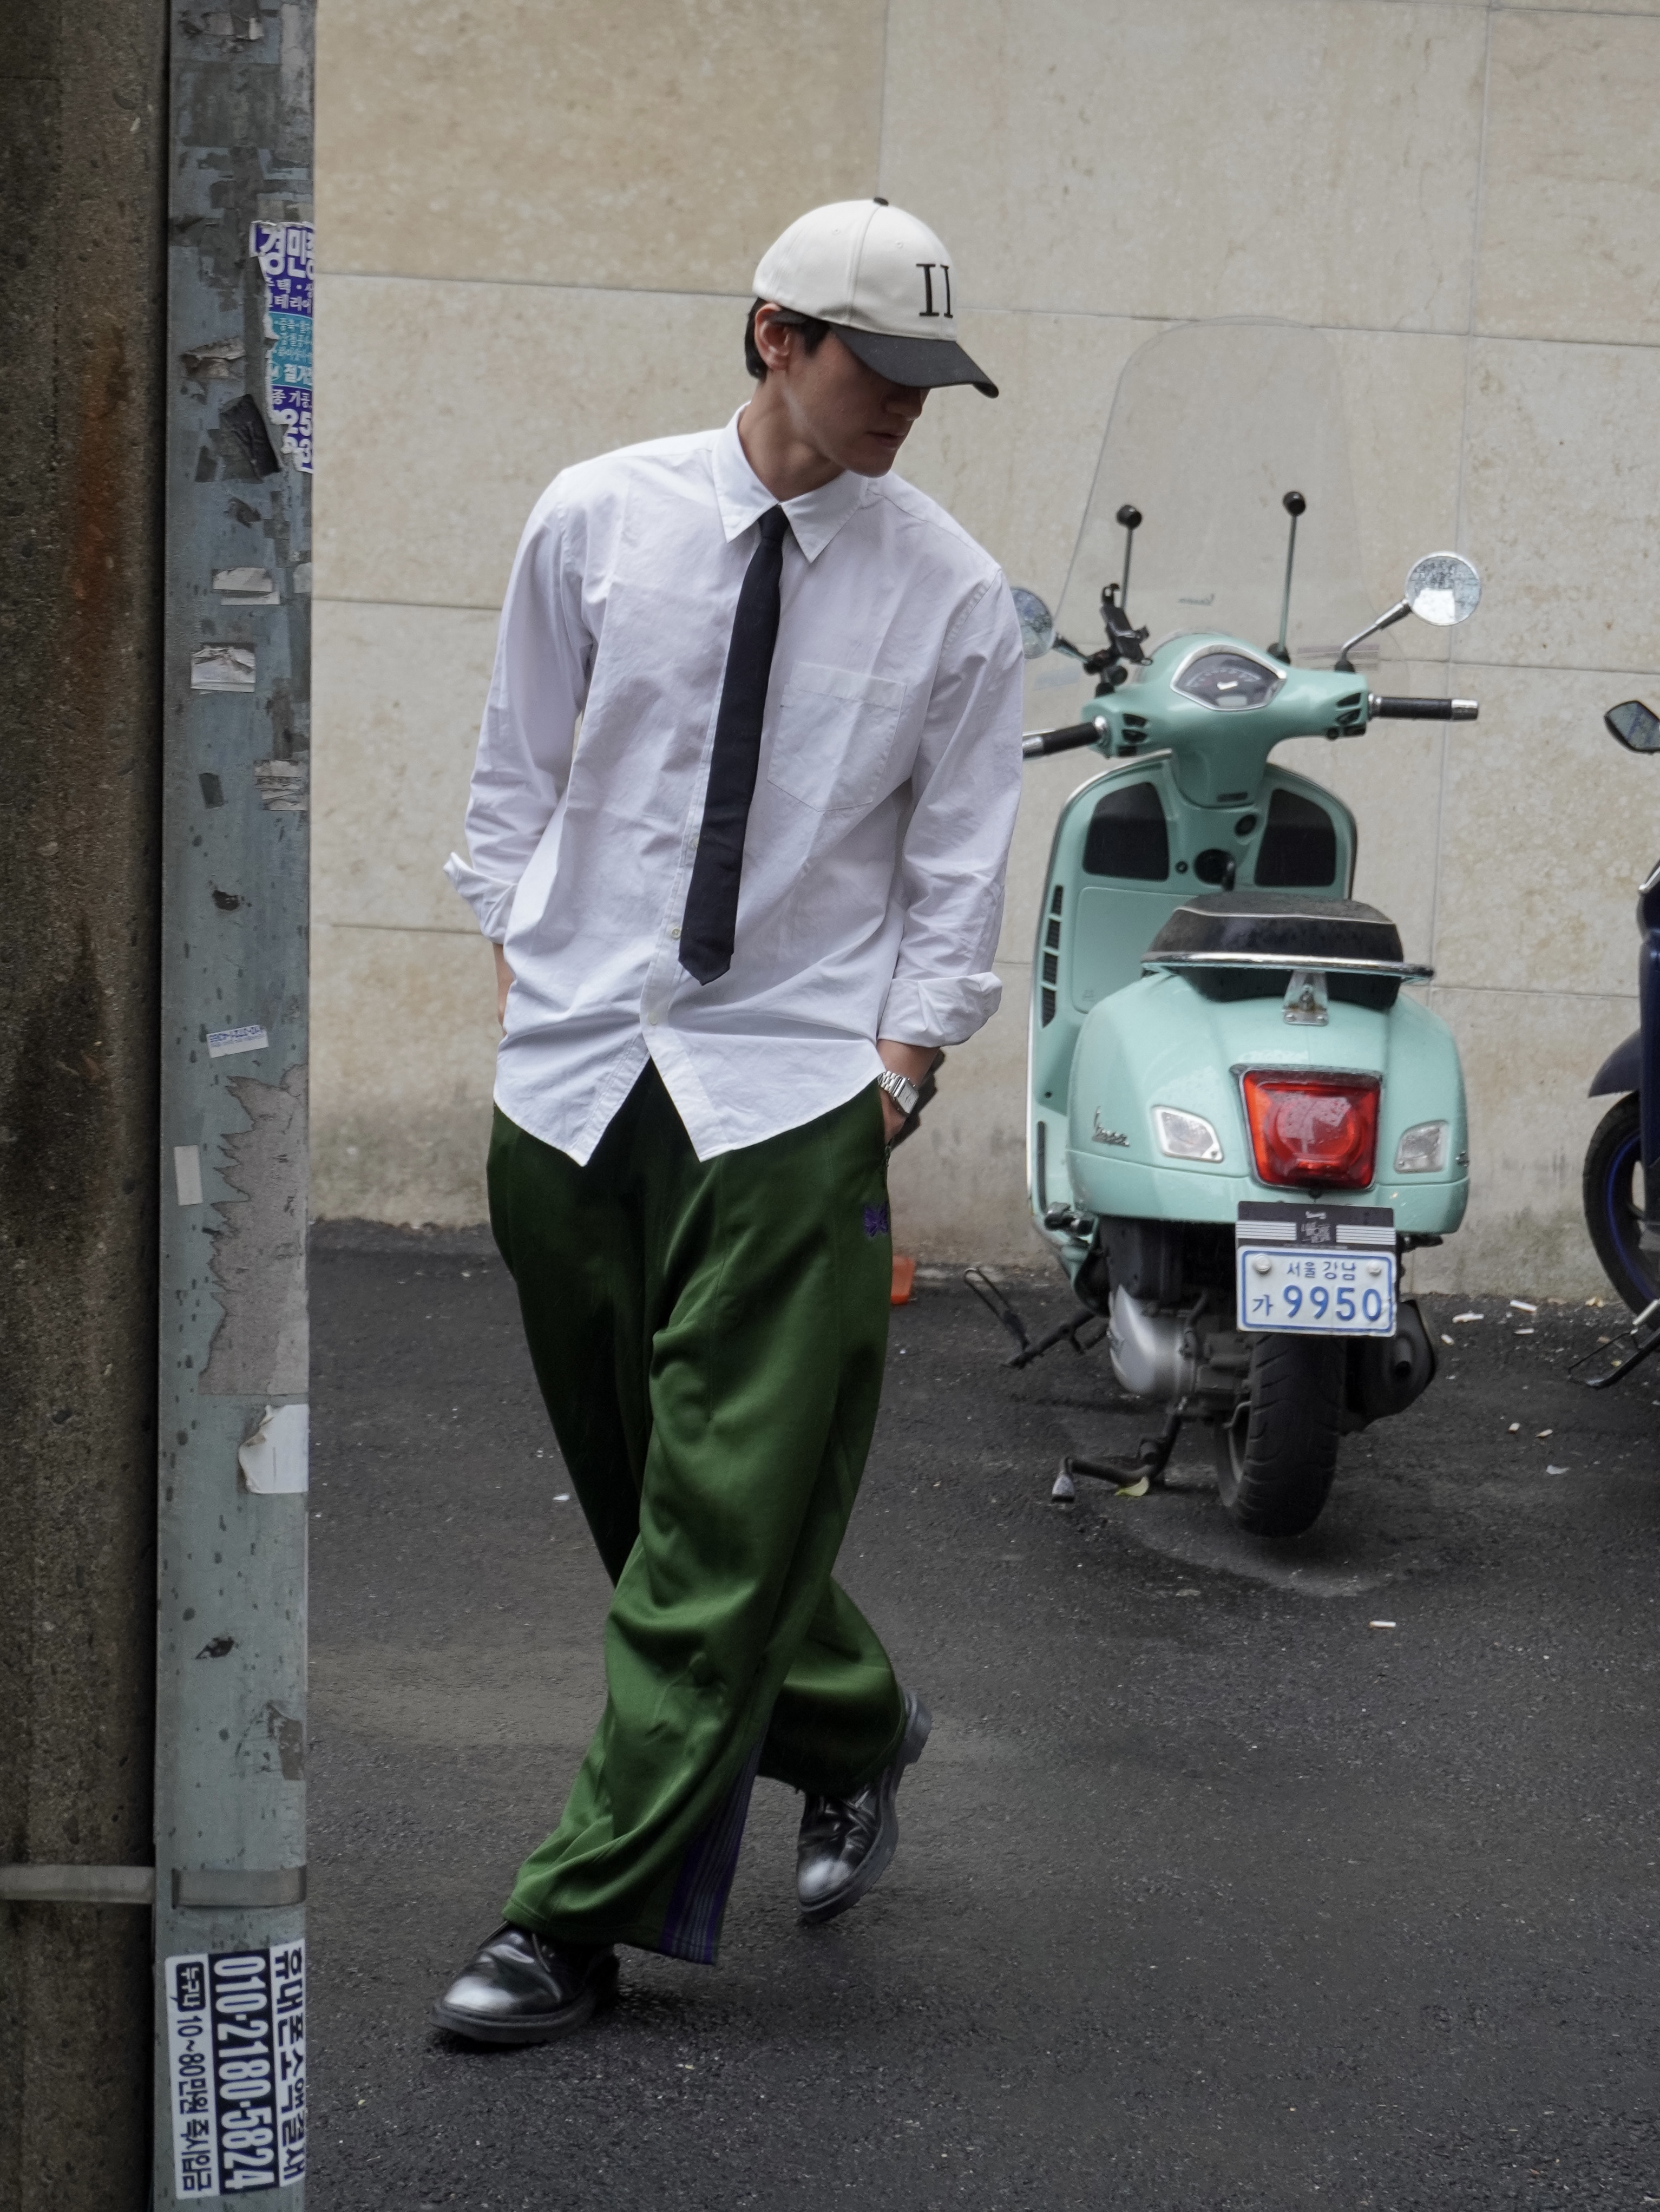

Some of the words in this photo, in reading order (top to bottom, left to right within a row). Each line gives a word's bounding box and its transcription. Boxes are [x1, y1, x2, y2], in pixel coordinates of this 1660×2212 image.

[1287, 1262, 1316, 1278] 서울
[1323, 1262, 1356, 1281] 강남
[1252, 1294, 1273, 1316] 가
[1283, 1285, 1382, 1321] 9950
[180, 1966, 201, 2010] 누구나
[180, 2118, 212, 2192] 즉시입금
